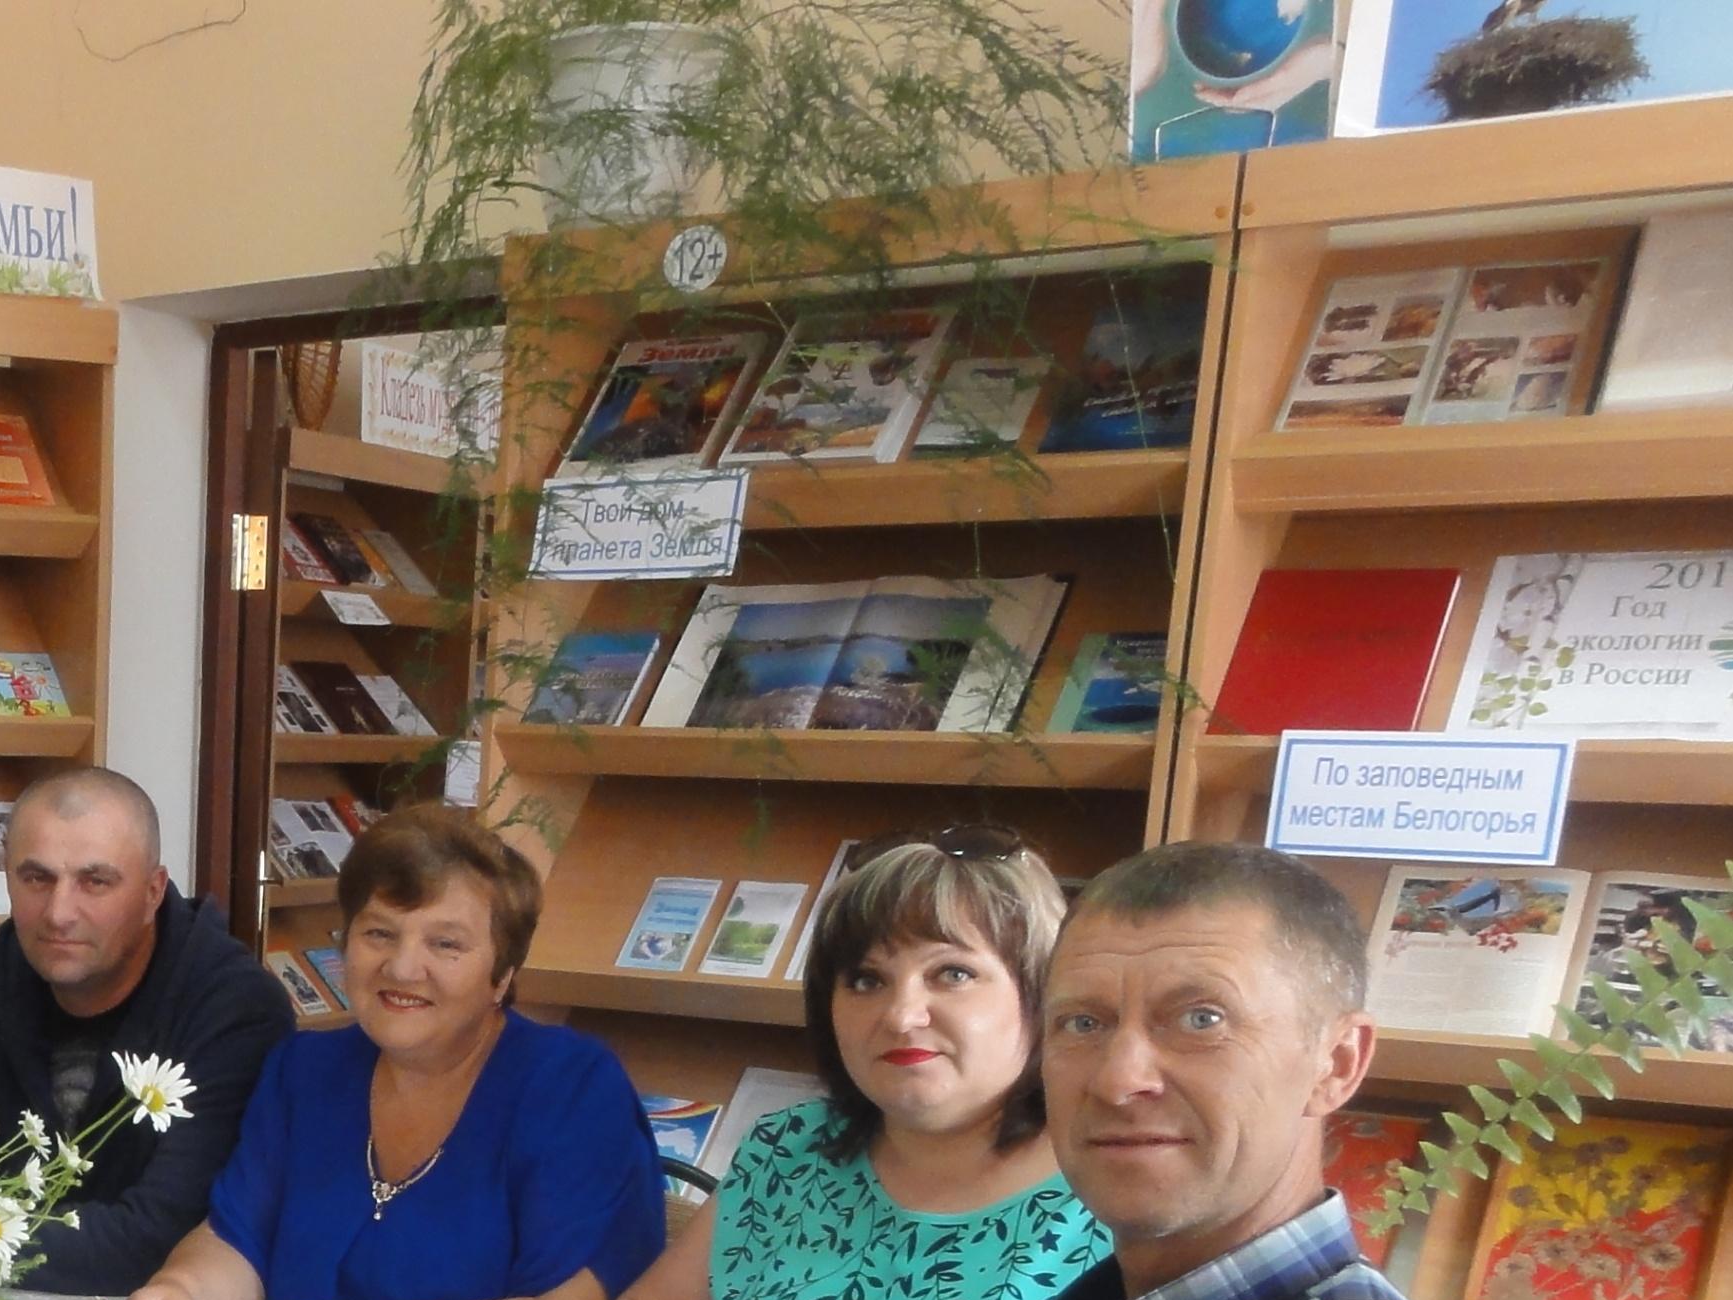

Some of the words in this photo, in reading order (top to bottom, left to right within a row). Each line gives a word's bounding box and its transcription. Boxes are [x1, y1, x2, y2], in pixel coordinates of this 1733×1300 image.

[673, 237, 723, 284] 12+
[1609, 595, 1667, 621] Год
[1567, 631, 1704, 653] экологии
[1557, 667, 1575, 686] в
[1584, 662, 1693, 687] России
[1313, 757, 1350, 788] По
[1355, 765, 1524, 793] заповедным
[1288, 801, 1385, 831] местам
[1393, 802, 1537, 840] Белогорья
